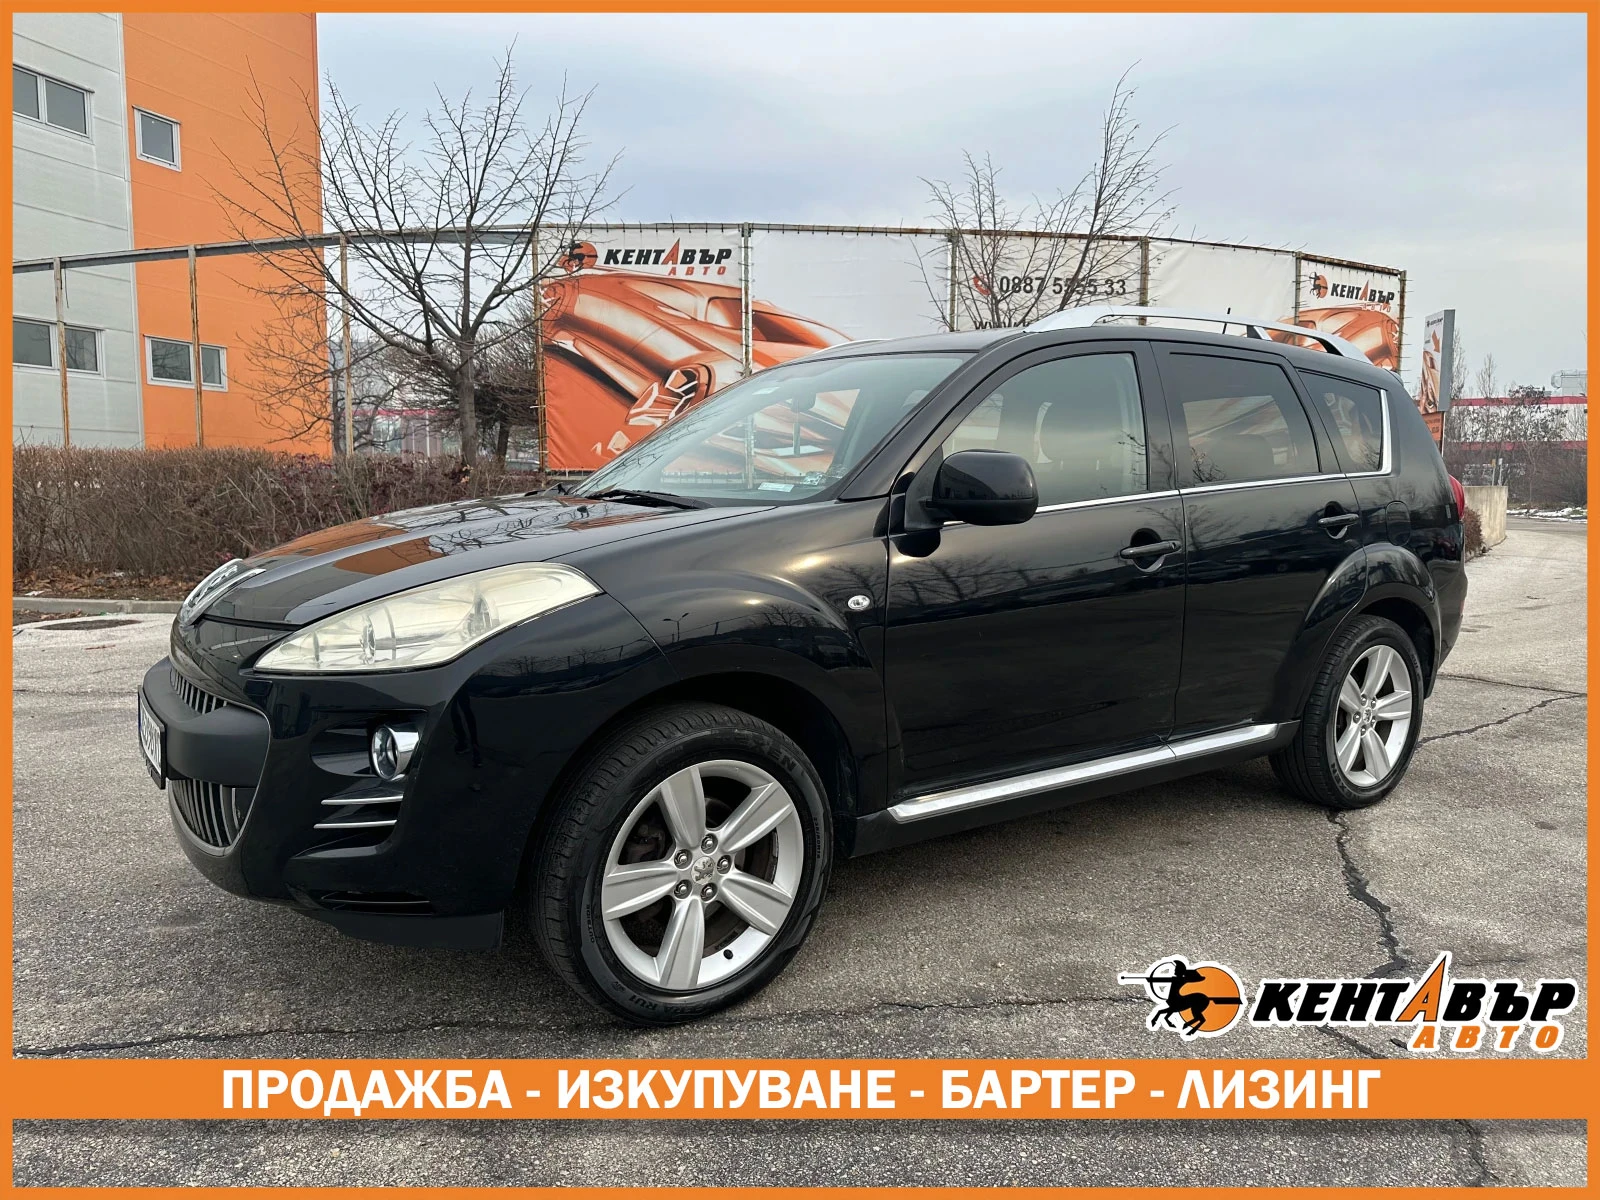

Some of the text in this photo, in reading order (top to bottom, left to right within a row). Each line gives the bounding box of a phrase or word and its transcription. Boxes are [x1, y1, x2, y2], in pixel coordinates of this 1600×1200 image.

[603, 238, 732, 265] КЕНТАВЪР
[668, 265, 727, 276] АВТО
[1000, 276, 1046, 293] 0887
[1104, 278, 1126, 295] 33
[1331, 280, 1395, 304] КЕНТАВЪР
[585, 902, 596, 944] OUTSIDE
